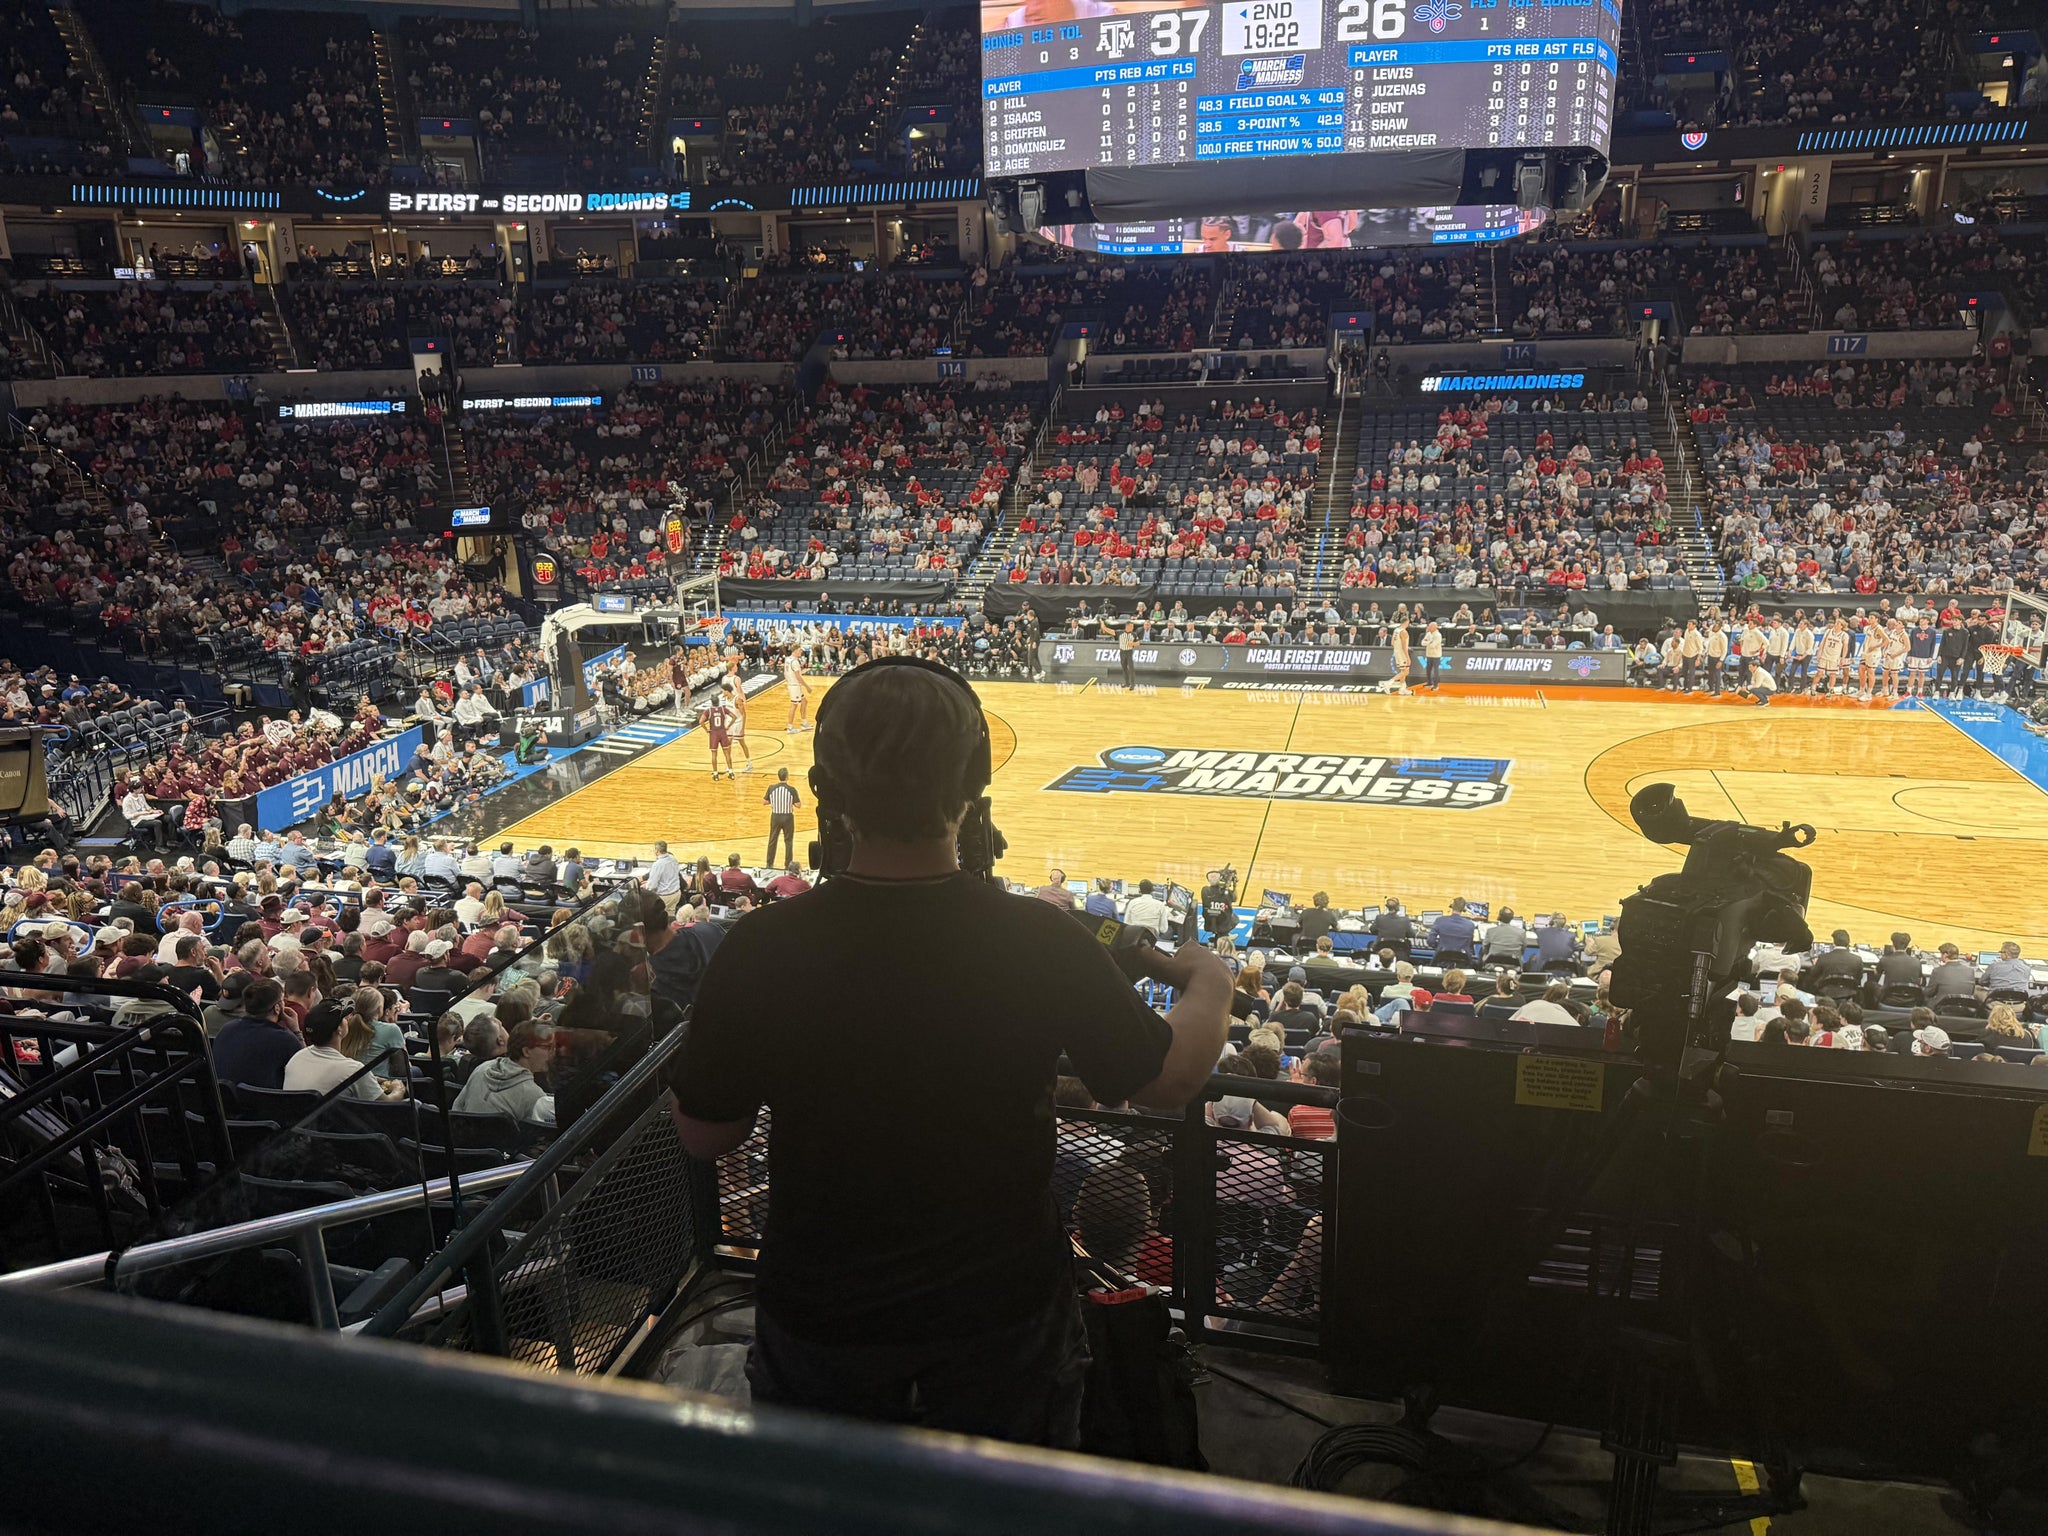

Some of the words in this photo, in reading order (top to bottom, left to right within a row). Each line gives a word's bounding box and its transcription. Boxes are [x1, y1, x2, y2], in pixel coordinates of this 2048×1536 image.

[1253, 1, 1292, 20] 2ND
[1337, 0, 1406, 41] 26
[1480, 17, 1489, 31] 1
[1515, 16, 1526, 29] 3
[982, 32, 1024, 52] BONUS
[1031, 28, 1054, 44] FLS
[1060, 25, 1083, 41] TOL
[1150, 10, 1210, 55] 37
[1243, 22, 1299, 49] 19:22
[1040, 51, 1049, 63] 0
[1069, 47, 1079, 60] 3
[1354, 49, 1398, 62] PLAYER
[1487, 44, 1511, 56] PTS
[1515, 44, 1539, 55] REB
[1543, 43, 1568, 55] AST
[1573, 43, 1594, 54] FLS
[1253, 59, 1286, 72] MARCH
[1354, 69, 1364, 81] 0
[1372, 67, 1414, 80] LEWIS
[1493, 64, 1503, 76] 3
[1521, 63, 1530, 75] 0
[1549, 62, 1558, 74] 0
[1578, 62, 1587, 74] 0
[988, 80, 1021, 94] PLAYER
[1095, 70, 1116, 81] PTS
[1119, 67, 1141, 80] REB
[1145, 65, 1167, 77] AST
[1172, 63, 1193, 75] FLS
[1256, 69, 1302, 84] MADNESS
[989, 100, 997, 111] 0
[1004, 97, 1027, 110] HILL
[1102, 88, 1110, 99] 4
[1127, 85, 1135, 97] 2
[1153, 83, 1160, 94] 1
[1178, 81, 1187, 92] 0
[1354, 87, 1363, 98] 6
[1371, 83, 1426, 97] JUZENAS
[1492, 81, 1502, 93] 0
[1520, 80, 1530, 92] 0
[1548, 79, 1558, 91] 0
[1576, 79, 1586, 91] 0
[1199, 100, 1223, 111] 48.3
[1229, 96, 1263, 109] FIELD
[1266, 94, 1297, 107] GOAL
[1300, 94, 1311, 105] %
[1318, 92, 1344, 104] 40.9
[1354, 103, 1362, 115] 7
[1371, 102, 1405, 114] DENT
[1488, 98, 1504, 110] 10
[1519, 97, 1528, 109] 3
[1547, 97, 1556, 108] 3
[1575, 96, 1584, 108] 0
[990, 115, 998, 127] 2
[1003, 111, 1042, 125] ISAACS
[1102, 104, 1110, 115] 0
[1127, 102, 1135, 113] 0
[1152, 100, 1161, 111] 2
[1178, 98, 1187, 109] 2
[990, 131, 998, 142] 3
[1004, 126, 1047, 140] GRIFFEN
[1102, 120, 1111, 131] 2
[1127, 118, 1135, 129] 1
[1152, 116, 1160, 127] 0
[1178, 114, 1187, 125] 2
[1198, 121, 1222, 133] 38.5
[1237, 117, 1287, 131] 3-POINT
[1289, 116, 1300, 127] %
[1317, 114, 1343, 126] 42.9
[1350, 120, 1364, 132] 11
[1371, 118, 1408, 131] SHAW
[1490, 115, 1499, 127] 3
[1518, 114, 1527, 125] 0
[1545, 113, 1555, 125] 0
[1574, 113, 1581, 124] 1
[990, 146, 998, 156] 9
[1004, 139, 1066, 155] DOMINGUEZ
[1100, 135, 1112, 147] 11
[1127, 133, 1135, 144] 0
[1152, 131, 1160, 142] 0
[1178, 130, 1186, 140] 0
[1198, 143, 1221, 155] 100.0
[1224, 141, 1253, 153] FREE
[1256, 138, 1299, 151] THROW
[1301, 138, 1312, 149] %
[1316, 137, 1341, 148] 50.0
[1348, 137, 1365, 148] 45
[1370, 134, 1437, 148] MCKEEVER
[1489, 132, 1498, 143] 0
[1516, 131, 1526, 142] 4
[1544, 130, 1553, 142] 2
[1573, 130, 1580, 141] 1
[988, 161, 1000, 172] 12
[1004, 158, 1030, 170] AGEE
[1100, 151, 1112, 162] 11
[1127, 149, 1136, 160] 2
[1152, 147, 1161, 158] 2
[1178, 145, 1186, 157] 1
[1810, 173, 1821, 205] 225
[416, 193, 479, 212] FIRST
[482, 199, 498, 208] AND
[502, 194, 582, 212] SECOND
[586, 192, 668, 211] ROUNDS
[280, 226, 291, 256] 219
[1507, 346, 1530, 359] 116
[1834, 338, 1861, 352] 117
[636, 368, 657, 380] 113
[942, 363, 962, 375] 114
[1420, 374, 1584, 392] #MARCHMADNESS
[294, 401, 391, 418] MARCHMADNESS
[474, 399, 504, 409] FIRST
[513, 398, 552, 407] SECOND
[552, 397, 591, 407] ROUNDS
[538, 571, 551, 580] 20
[732, 618, 754, 632] THE
[756, 618, 787, 633] ROAD
[1095, 649, 1121, 662] TEXA
[1246, 649, 1281, 663] NCAA
[1284, 650, 1320, 664] FIRST
[1324, 650, 1371, 665] ROUND
[1466, 657, 1501, 670] SAINT
[1504, 658, 1553, 671] MARY'S
[1222, 682, 1334, 692] OKLAHOMA
[714, 716, 721, 727] 0
[332, 741, 400, 796] MARCH
[1162, 750, 1388, 776] MARCH
[0, 770, 21, 778] Canon
[1177, 769, 1498, 801] MADNESS
